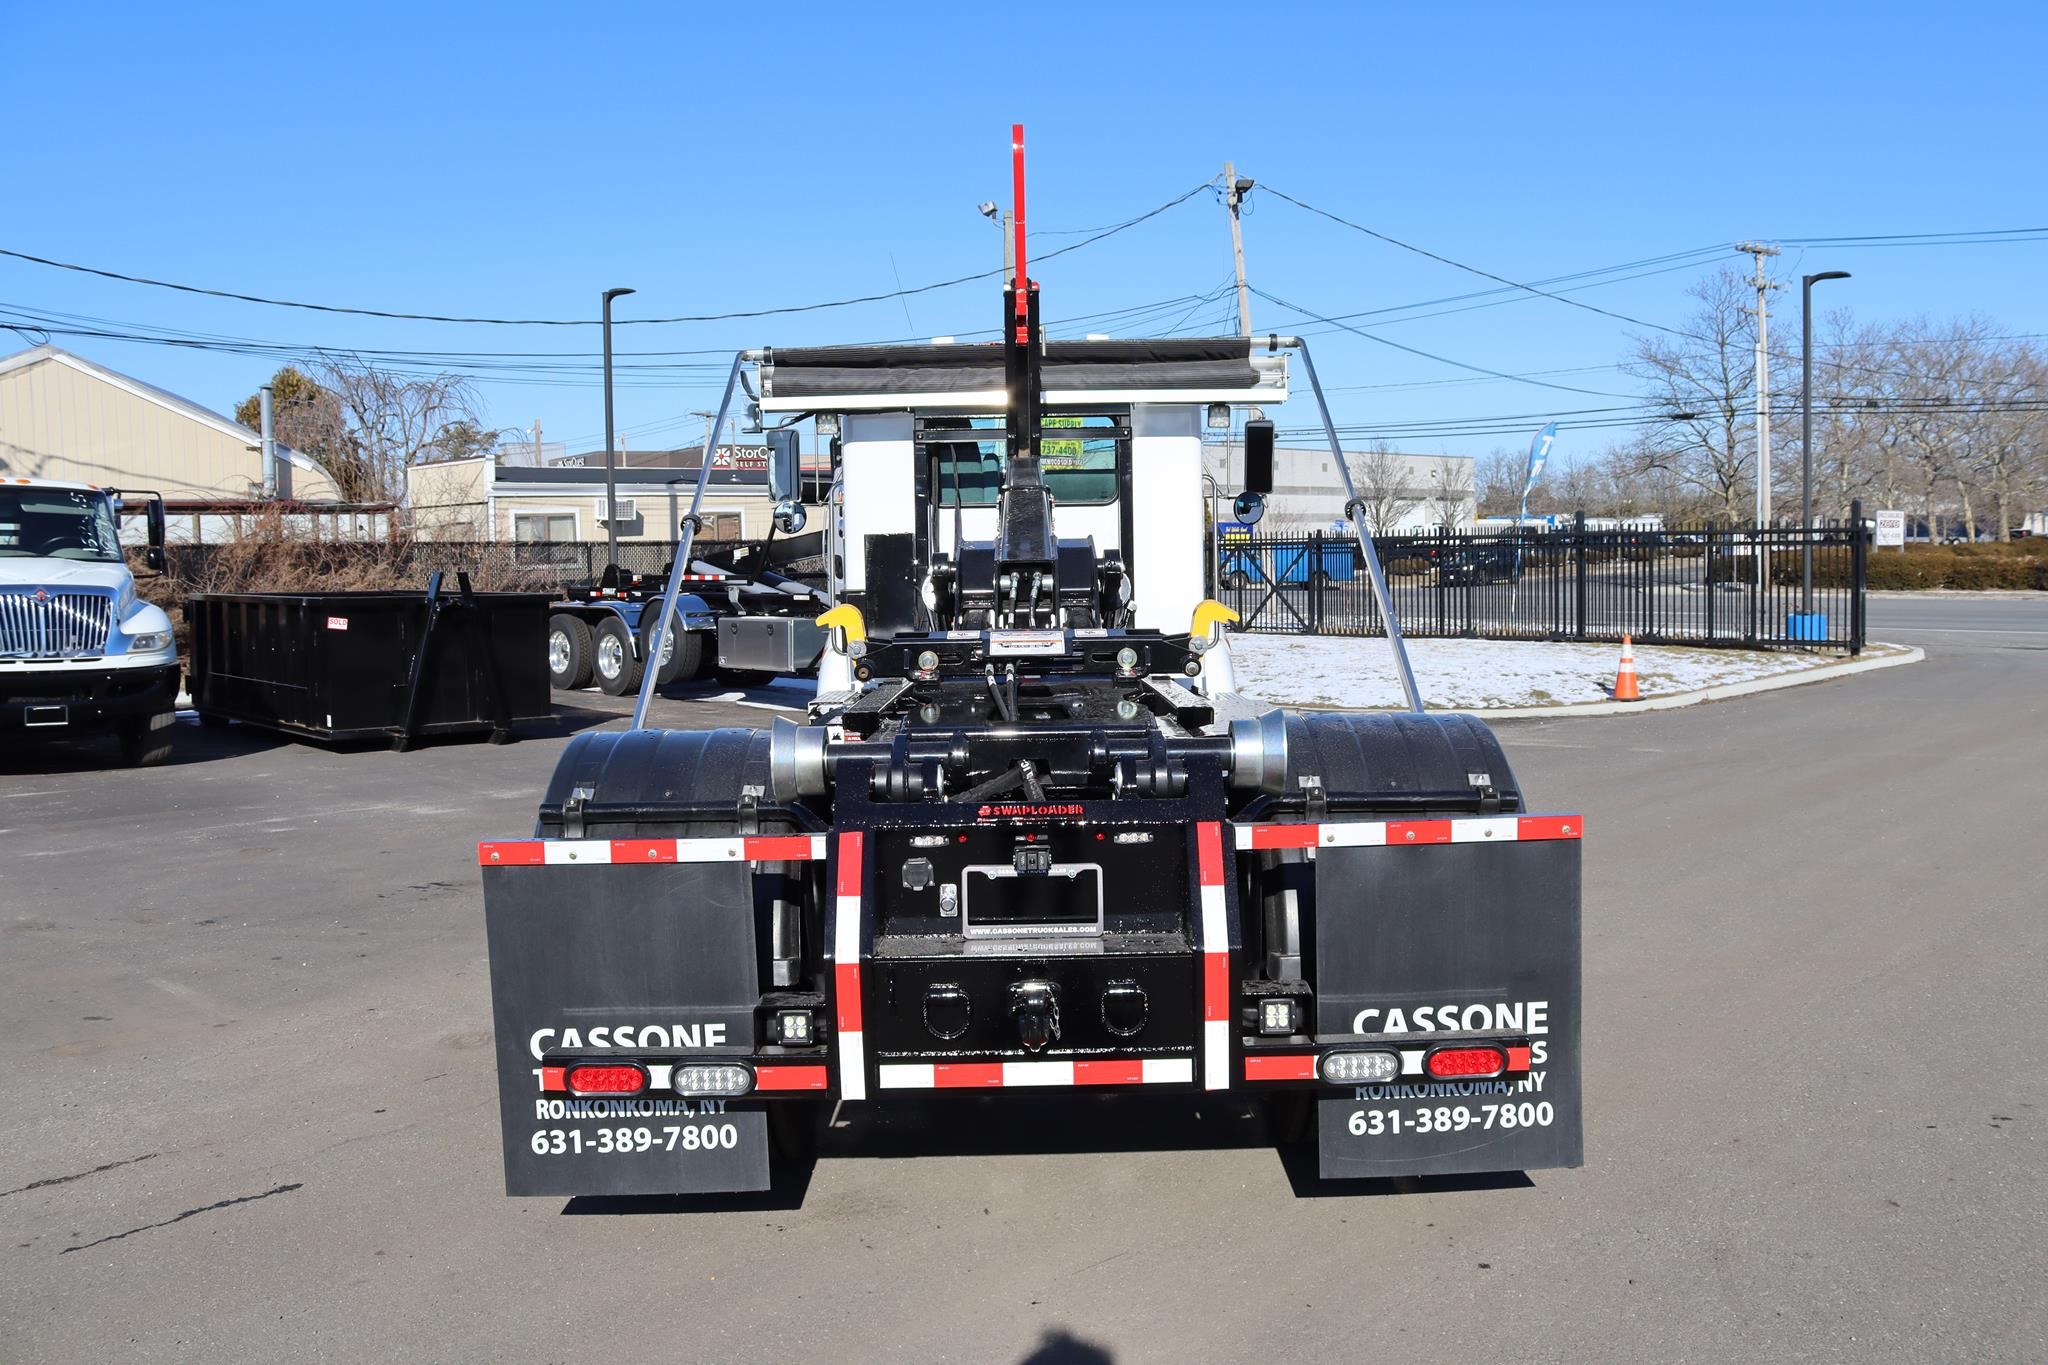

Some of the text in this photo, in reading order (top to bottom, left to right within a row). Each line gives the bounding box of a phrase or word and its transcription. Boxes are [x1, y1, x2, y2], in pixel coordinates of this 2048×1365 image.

[993, 804, 1084, 816] SWAPLOADER
[970, 926, 1097, 936] WWW.CASSONETRUCKSALES.COM
[1352, 1001, 1549, 1036] CASSONE
[529, 1023, 726, 1062] CASSONE
[1517, 1071, 1547, 1093] NY
[535, 1099, 728, 1120] RONKONKOMA, NY
[1348, 1101, 1554, 1136] 631-389-7800
[531, 1123, 738, 1155] 631-389-7800
